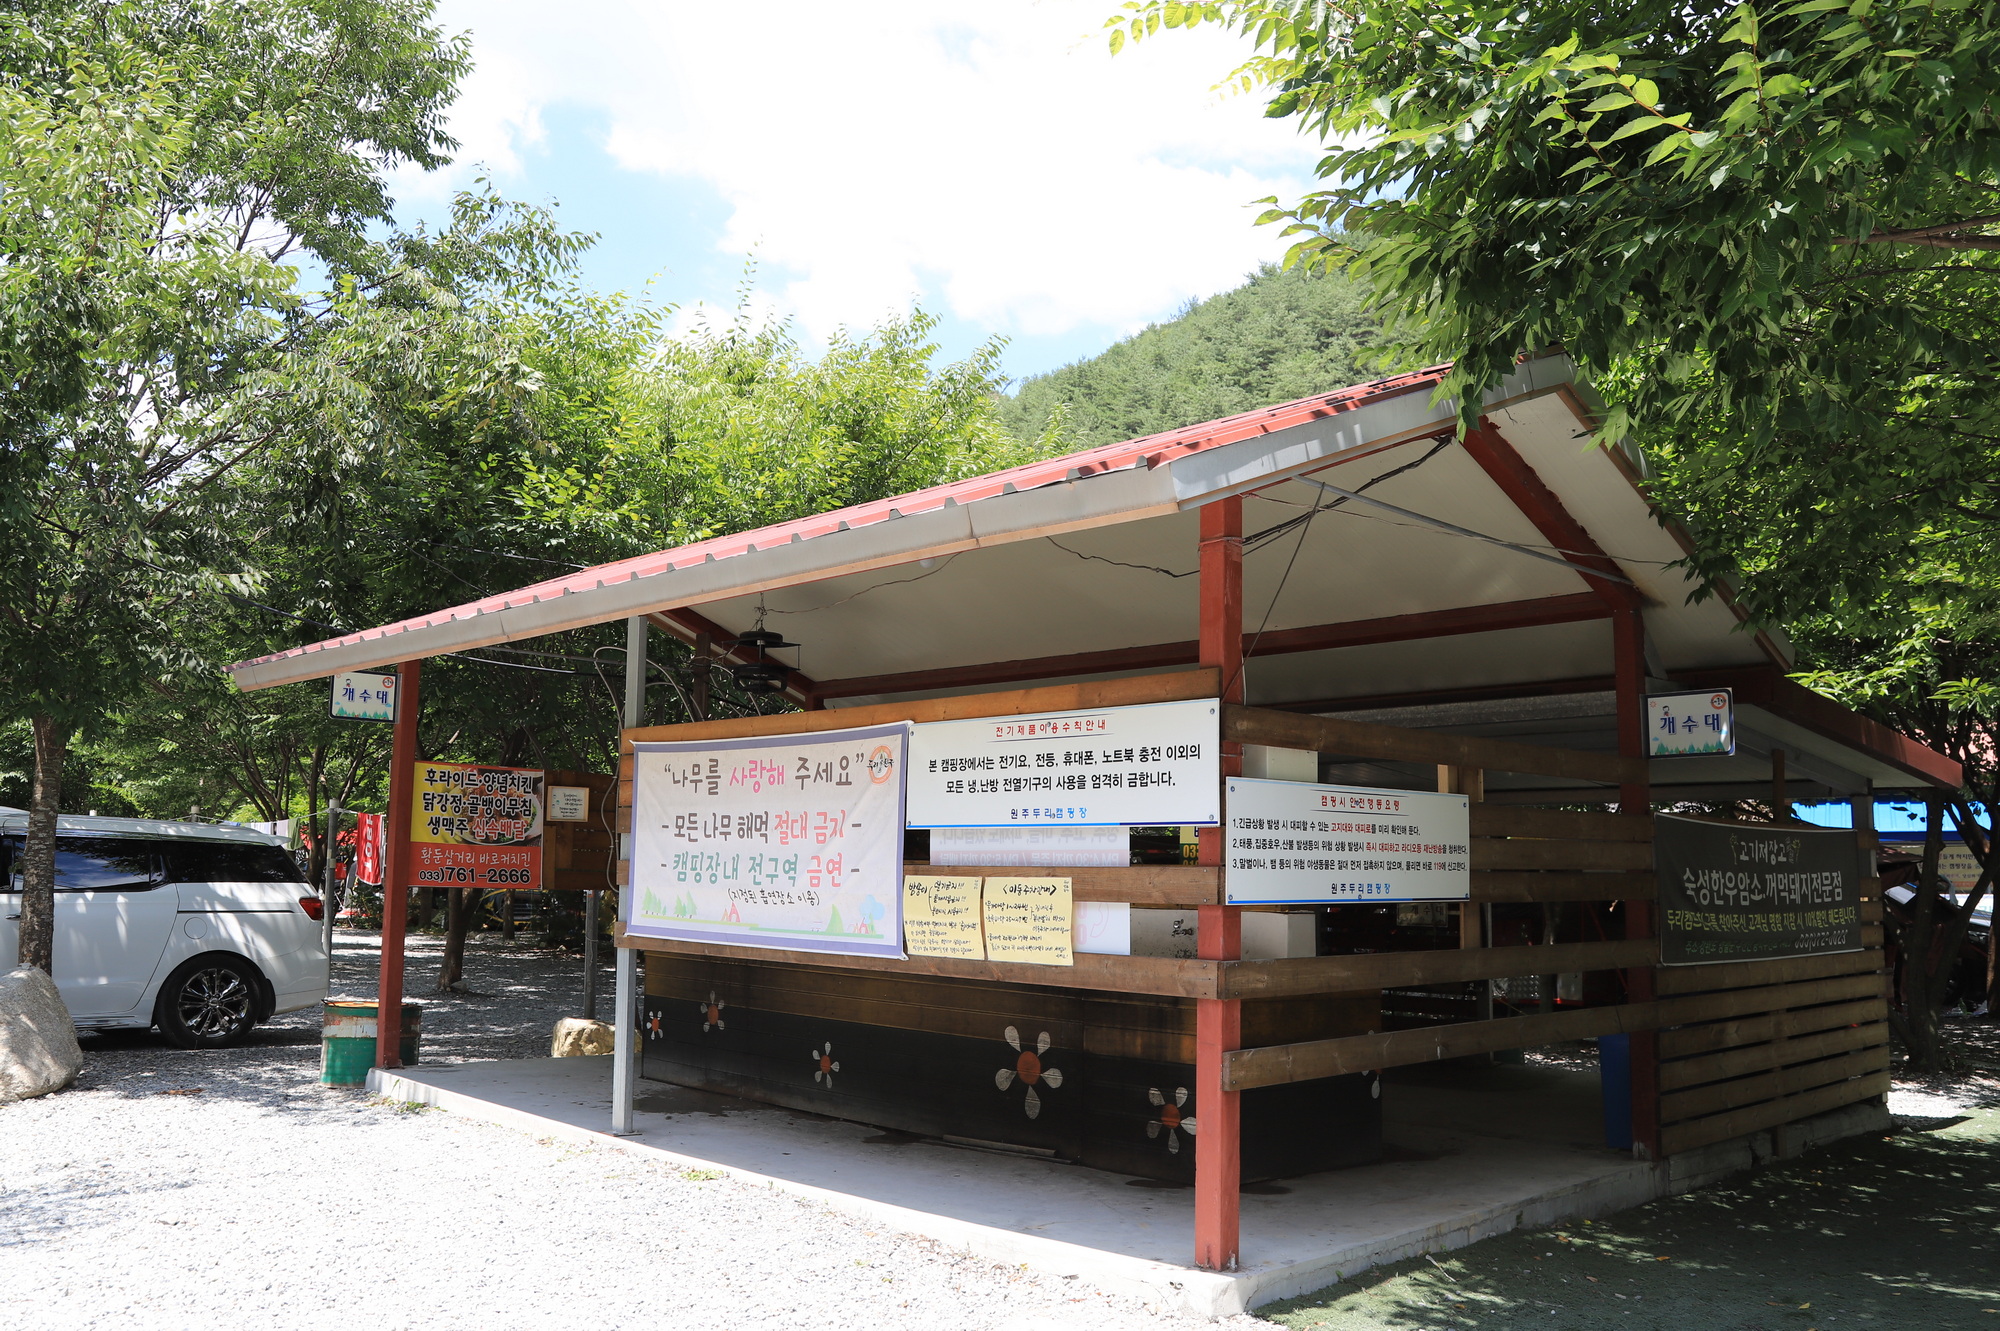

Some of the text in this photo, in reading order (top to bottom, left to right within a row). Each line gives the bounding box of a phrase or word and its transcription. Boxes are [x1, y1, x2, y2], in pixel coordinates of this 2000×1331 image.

[342, 688, 388, 704] 개수대
[1660, 714, 1721, 734] 개수대
[929, 744, 1201, 773] 본 캠핑장에서는 전기요, 전등, 휴대폰, 노트북 충전 이외의
[729, 759, 785, 794] 사랑해
[946, 771, 1176, 794] 모든 냉.난방 전열기구의 사용을 엄격히 금합니다.
[427, 816, 526, 840] 생맥주 신속배달
[674, 812, 699, 843] 모든
[703, 812, 732, 842] 나무
[737, 810, 769, 844] 해먹
[774, 810, 808, 846] 절대
[813, 809, 846, 844] 금지
[1267, 819, 1280, 831] 발생
[1282, 819, 1288, 831] 시
[1290, 820, 1308, 832] 대피할
[1309, 821, 1316, 832] 수
[1317, 821, 1329, 833] 있는
[1331, 822, 1354, 833] 고지대와
[1355, 823, 1377, 834] 대피로를
[1378, 824, 1390, 835] 미리
[1391, 825, 1407, 835] 확인해
[420, 847, 532, 867] 황둔삼거리 바로커치킨
[1296, 840, 1320, 851] 발생등의
[1321, 840, 1333, 852] 위험
[1334, 841, 1346, 852] 상황
[1348, 841, 1364, 852] 발생시
[1366, 842, 1377, 852] 즉시
[1378, 842, 1400, 853] 대피하고
[1401, 843, 1422, 854] 라디오등
[1423, 844, 1447, 854] 재난방송을
[1740, 839, 1787, 866] 고기저장고
[748, 852, 799, 888] 전구역
[807, 852, 843, 888] 금연
[1279, 859, 1291, 870] 등의
[1293, 859, 1306, 870] 위험
[1307, 859, 1336, 870] 야생동물은
[1337, 859, 1348, 871] 절대
[1350, 860, 1362, 870] 먼저
[1363, 860, 1385, 871] 접촉하지
[1406, 861, 1421, 871] 물리면
[1422, 861, 1433, 871] 바로
[1434, 861, 1446, 871] 119에
[418, 867, 531, 884] 033)761-2666
[728, 888, 757, 904] (지정된
[797, 891, 820, 906] 이용)
